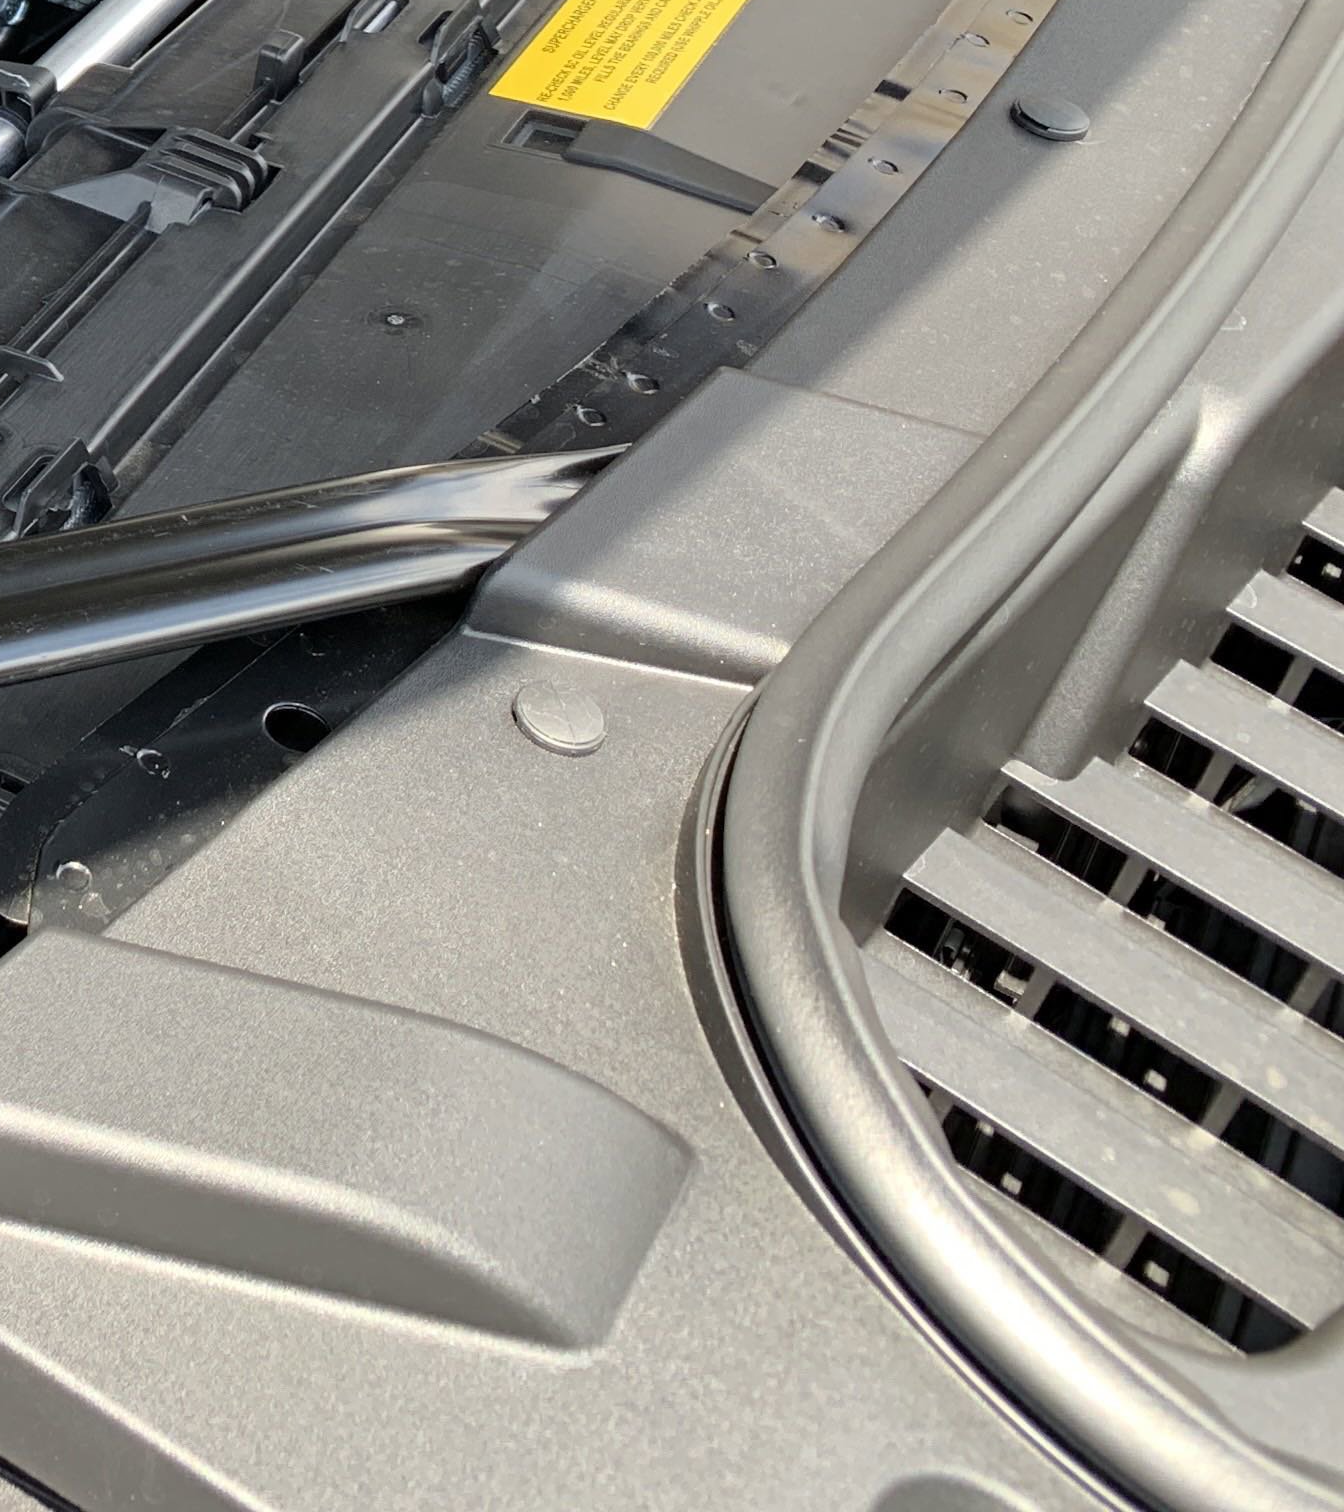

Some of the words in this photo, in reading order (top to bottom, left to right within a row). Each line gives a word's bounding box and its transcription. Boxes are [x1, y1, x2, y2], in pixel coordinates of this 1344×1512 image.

[613, 12, 639, 31] DROP
[642, 6, 664, 21] AND
[579, 28, 606, 49] LEVEL
[602, 30, 625, 45] MAY
[617, 20, 653, 52] BEARINGS
[570, 47, 590, 59] OIL
[586, 43, 614, 65] LEVEL
[602, 82, 636, 111] CHANGE
[623, 61, 652, 84] EVERY
[657, 20, 684, 41] MILES
[672, 0, 700, 22] CHECK
[644, 51, 681, 84] REQUIRED
[680, 9, 713, 37] WHIPPLE
[607, 50, 629, 65] THE
[592, 64, 618, 83] FILLS
[535, 68, 573, 102] RE-CHECK
